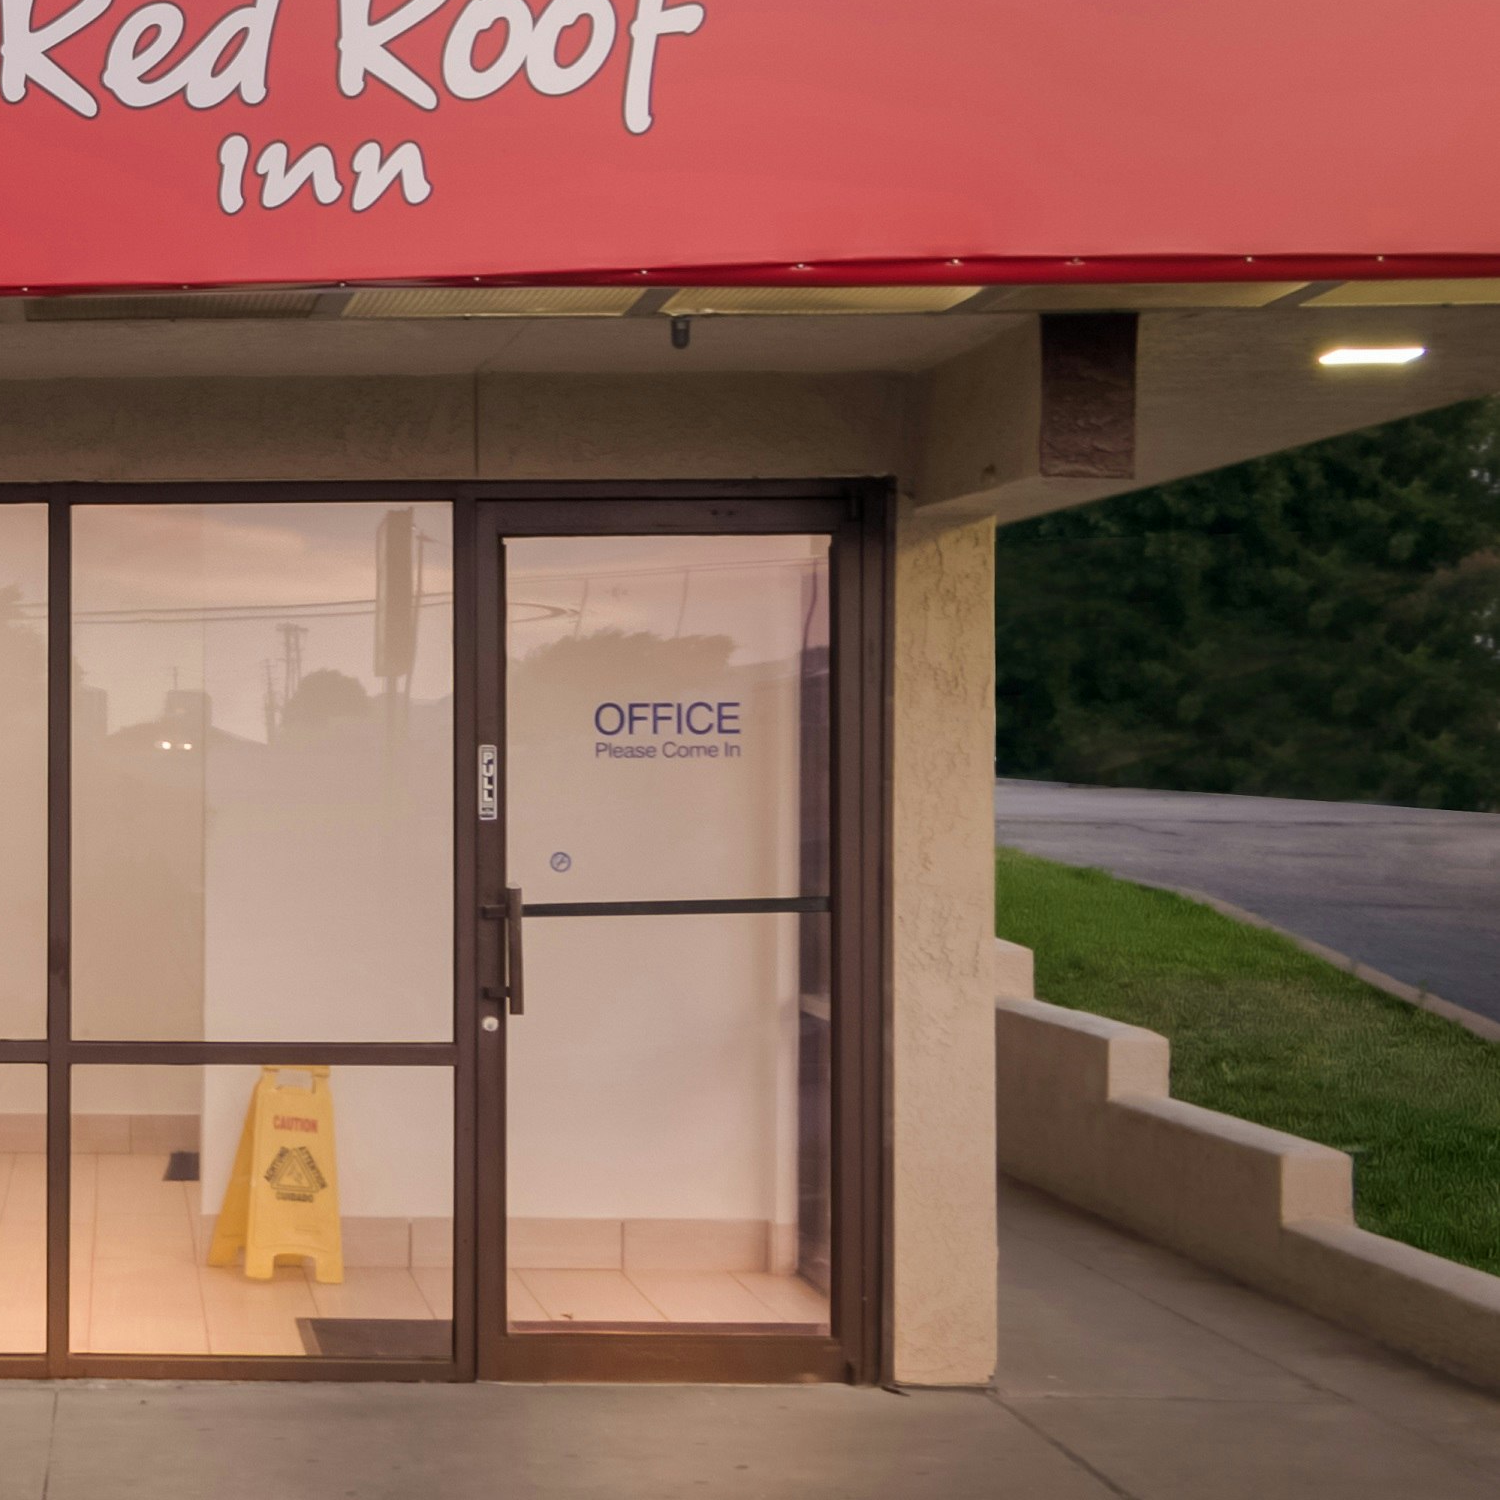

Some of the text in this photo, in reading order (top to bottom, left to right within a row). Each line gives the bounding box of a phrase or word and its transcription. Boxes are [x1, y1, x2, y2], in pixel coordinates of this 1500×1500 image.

[594, 701, 741, 736] OFFICE
[595, 741, 741, 759] Please Come In
[482, 752, 494, 802] PULL
[273, 1115, 319, 1133] CAUTION
